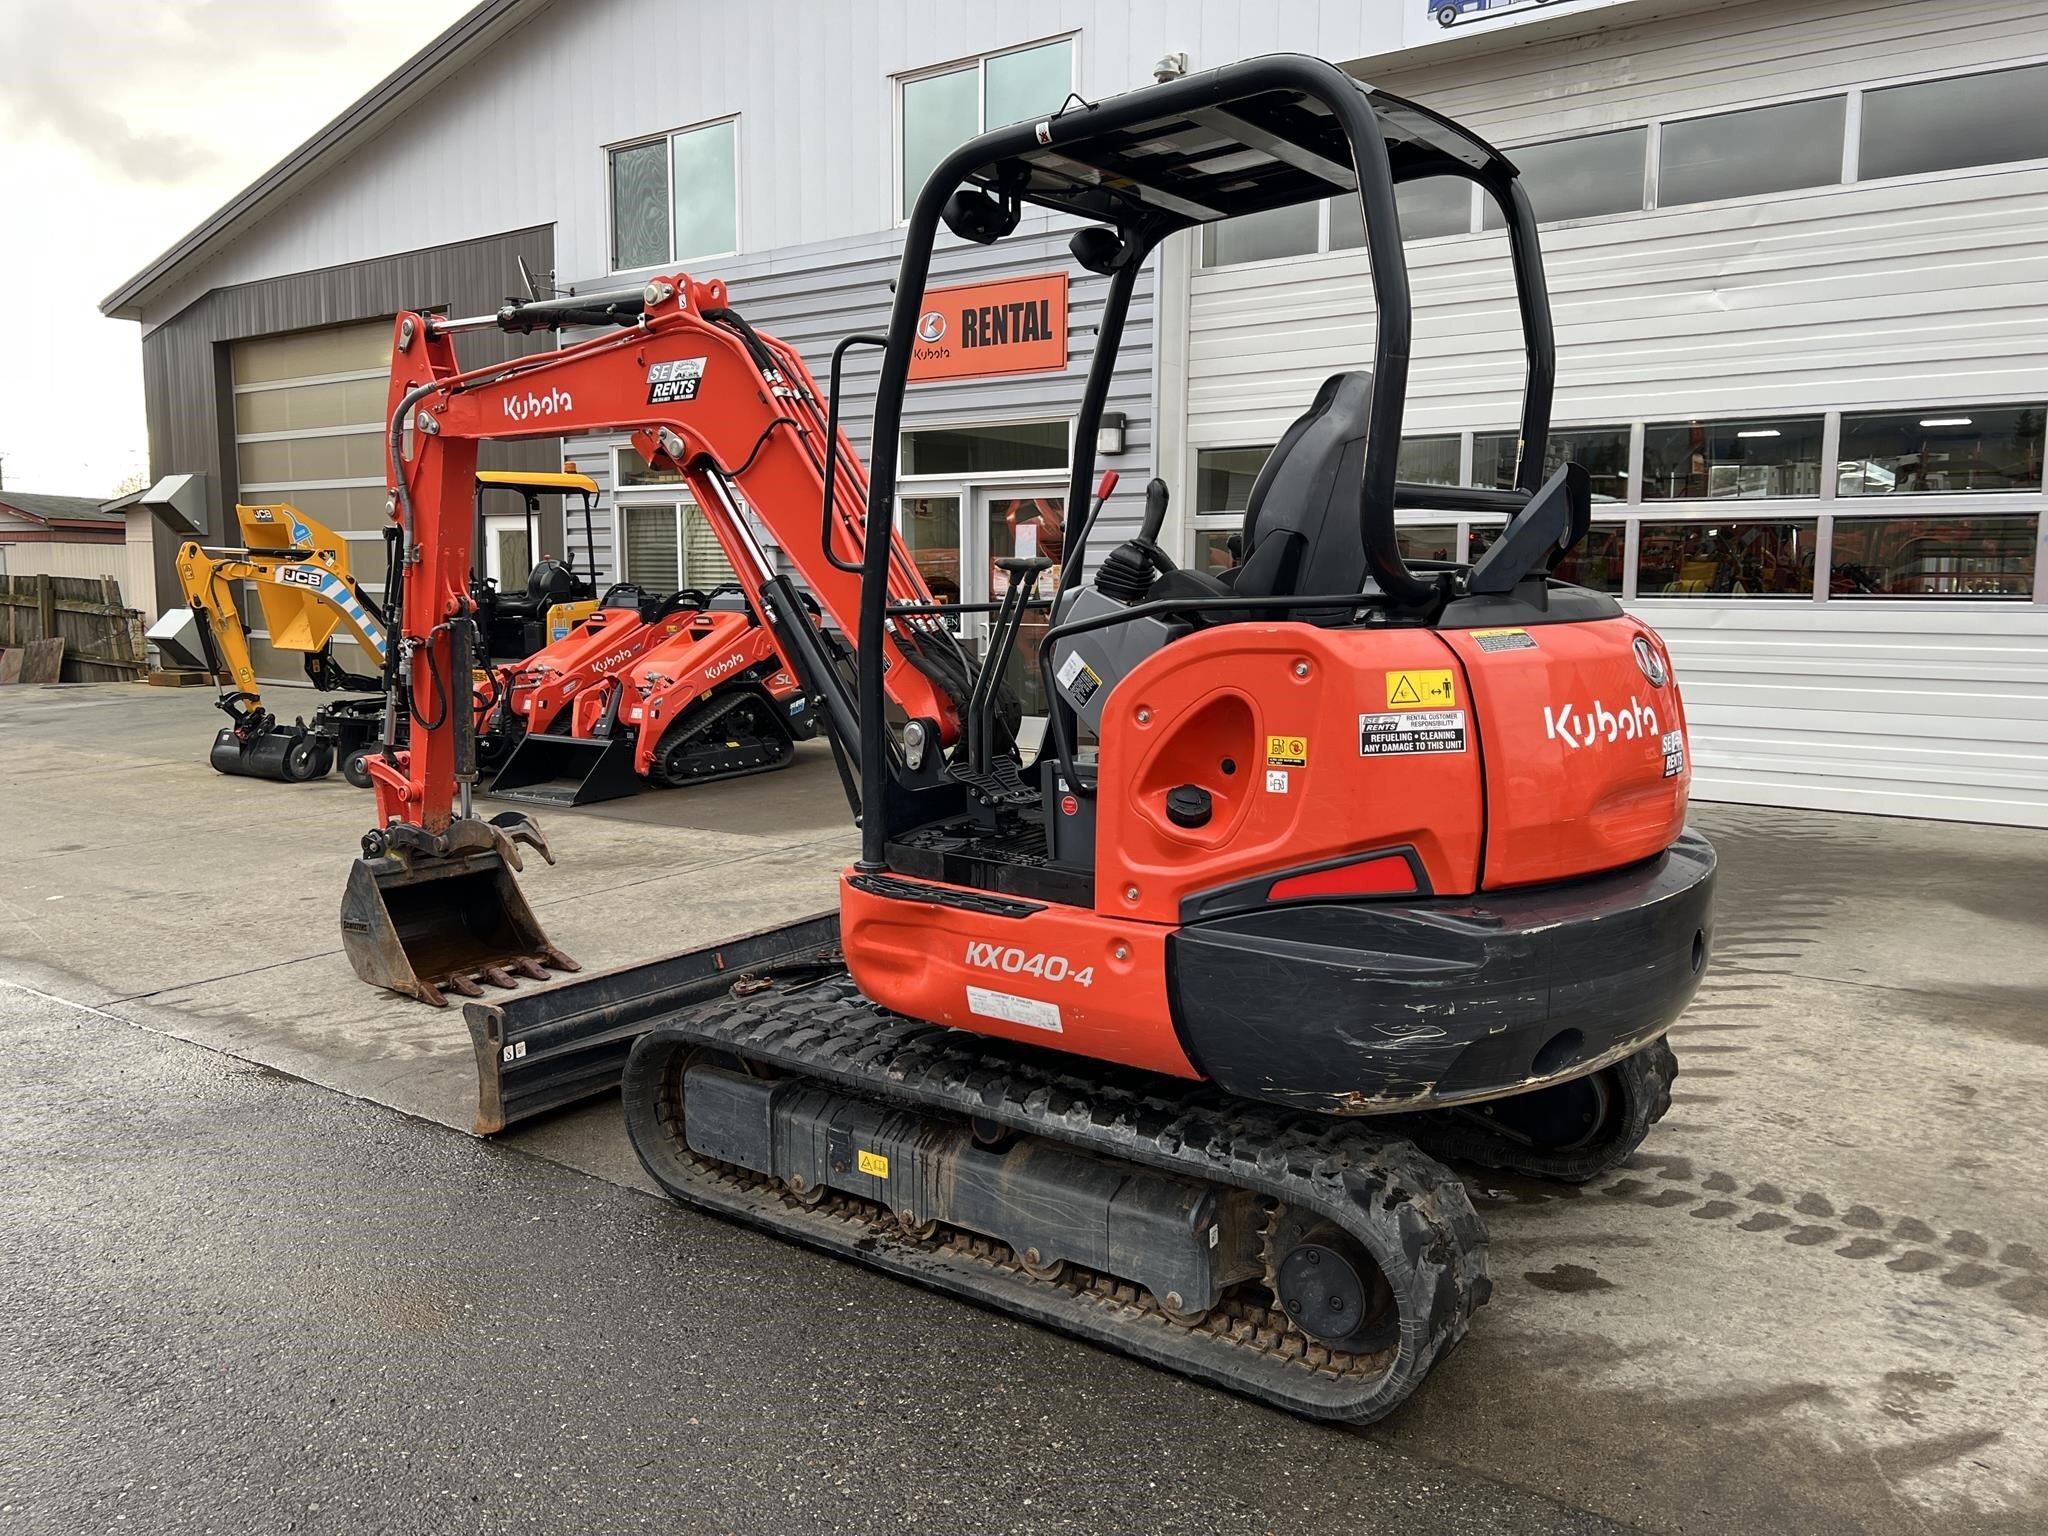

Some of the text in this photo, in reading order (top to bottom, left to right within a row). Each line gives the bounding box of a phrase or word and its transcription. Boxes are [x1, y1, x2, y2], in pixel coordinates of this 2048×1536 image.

[962, 299, 1052, 348] RENTAL
[914, 346, 950, 361] Kubota
[653, 380, 695, 397] RENTS
[503, 387, 573, 421] Kubota
[254, 509, 272, 518] JCB
[285, 570, 320, 586] JCB
[591, 649, 632, 673] Kubota
[704, 653, 744, 679] Kubota
[1544, 696, 1659, 749] Kubota
[1371, 731, 1455, 743] REFUELING CLEANING
[1364, 740, 1462, 753] ANY DAMAGE TO THIS UNIT
[1667, 753, 1682, 770] RENTS
[965, 941, 1094, 987] KX040-4
